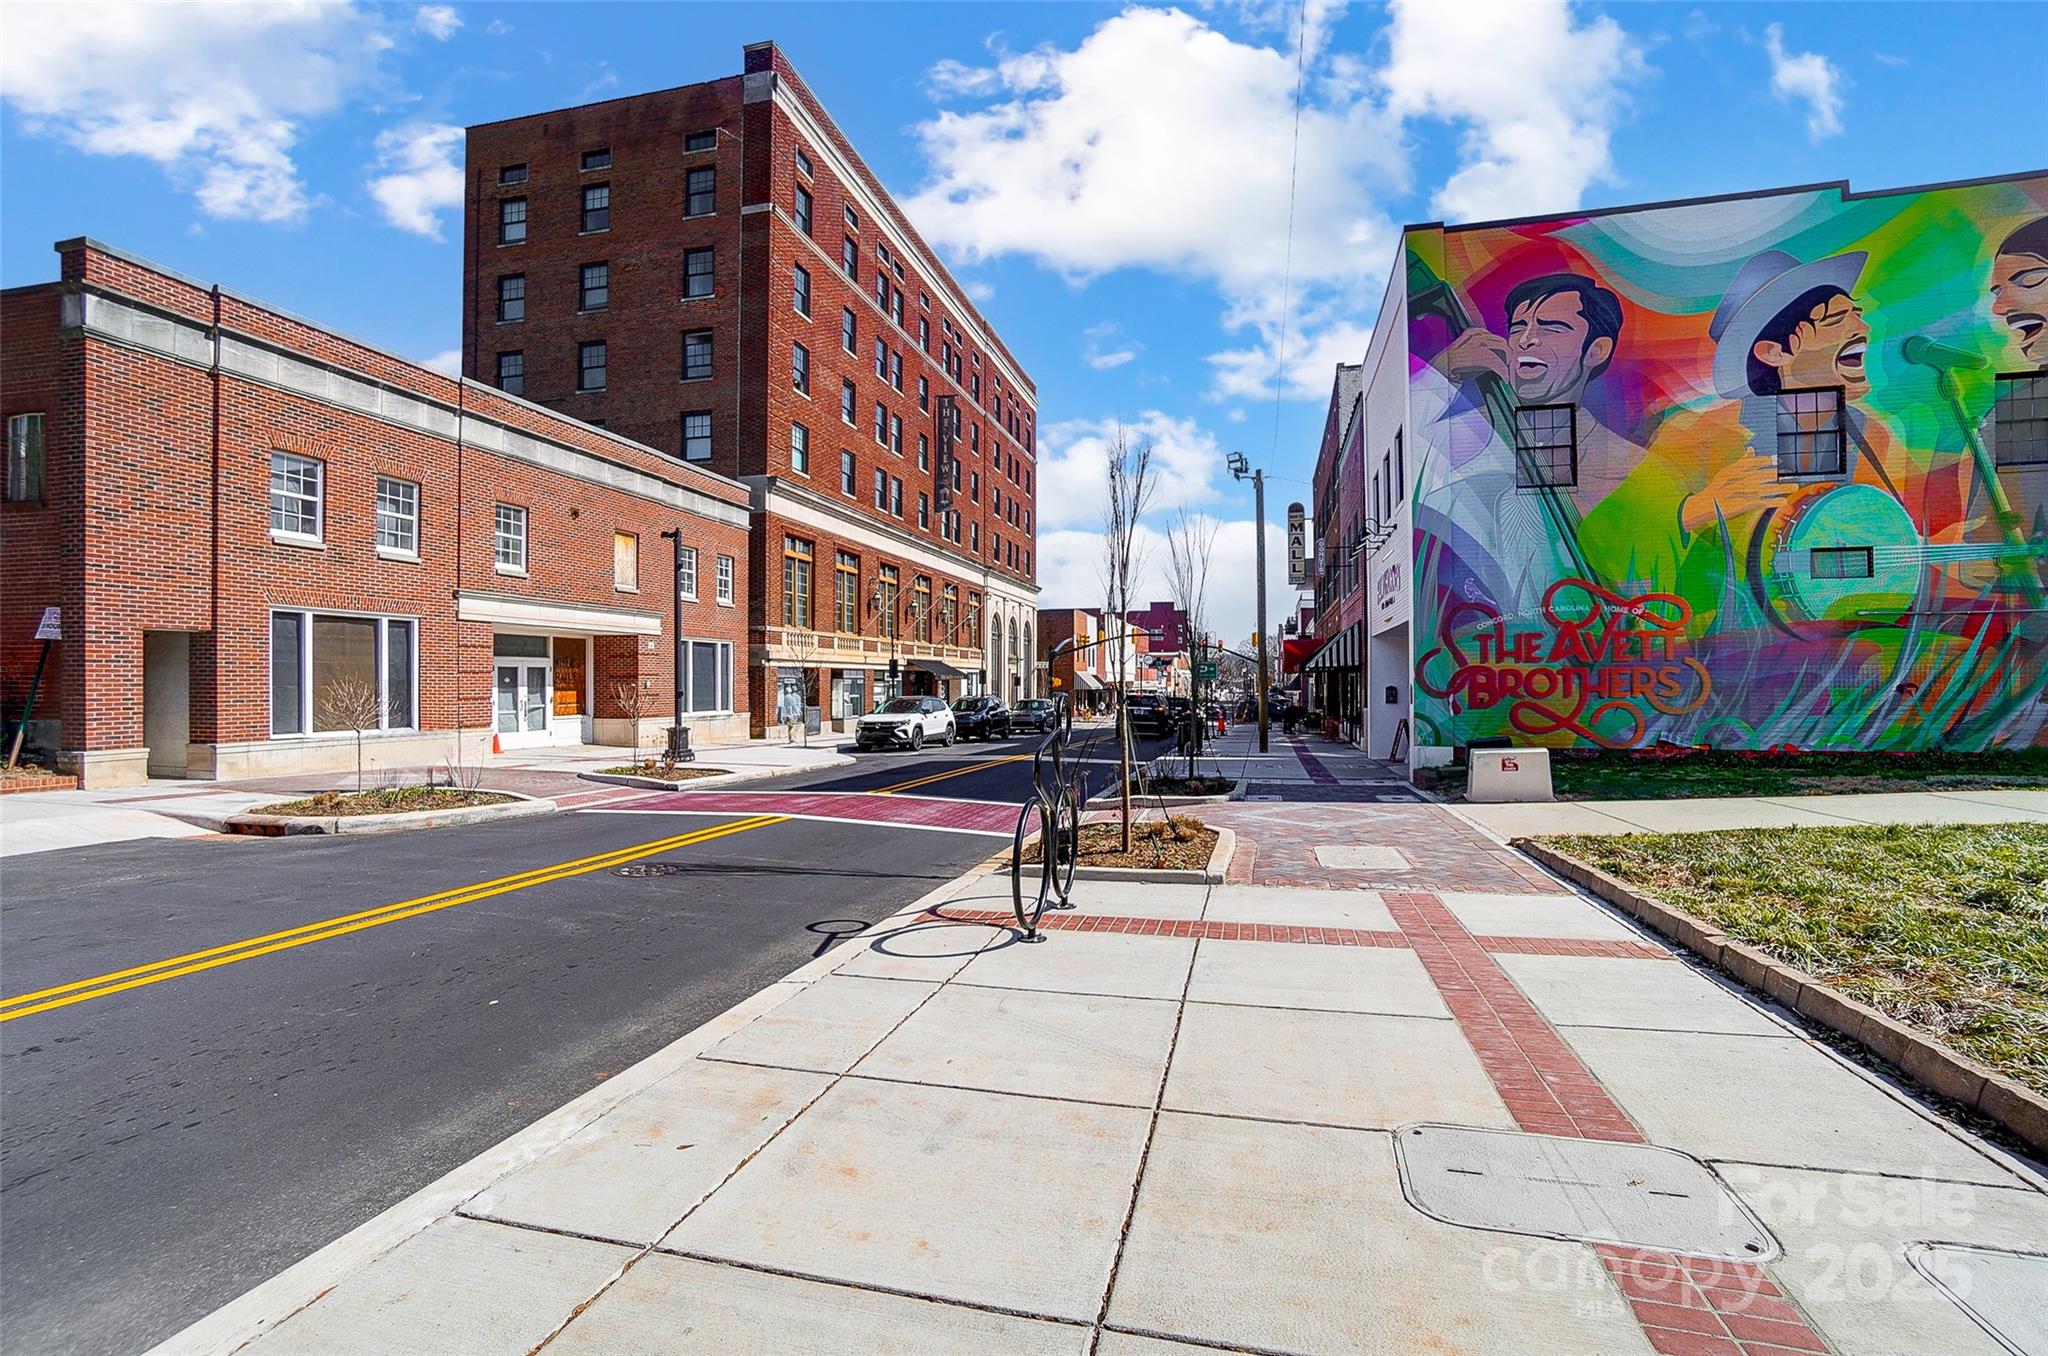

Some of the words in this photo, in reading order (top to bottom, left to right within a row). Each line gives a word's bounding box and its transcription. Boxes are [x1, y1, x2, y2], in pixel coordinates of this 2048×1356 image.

[942, 398, 950, 427] THE
[941, 435, 950, 472] VIEW
[1290, 522, 1303, 573] MALL
[1518, 606, 1546, 618] NORTH
[1548, 604, 1590, 614] CAROLINA
[1604, 605, 1629, 615] HOME
[1471, 631, 1547, 665] THE
[1546, 621, 1685, 664] AVETT
[1466, 664, 1682, 710] BROTHERS
